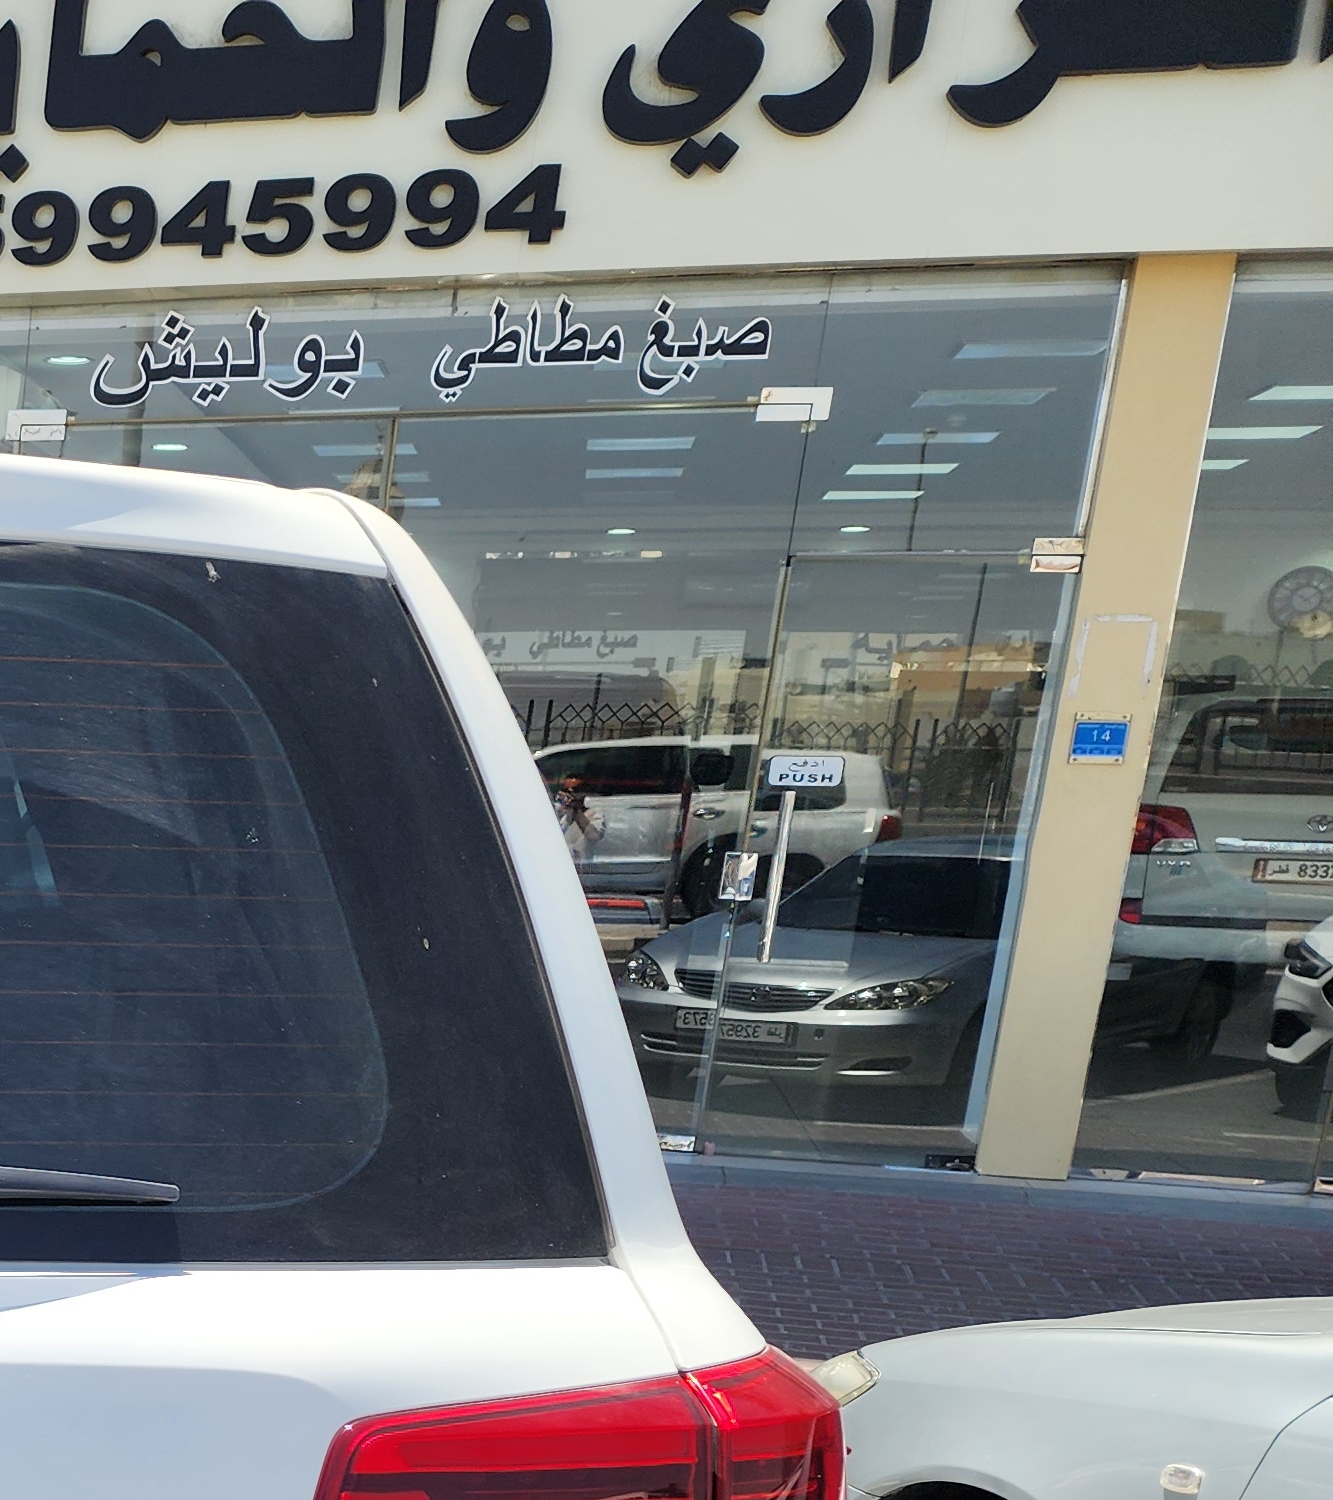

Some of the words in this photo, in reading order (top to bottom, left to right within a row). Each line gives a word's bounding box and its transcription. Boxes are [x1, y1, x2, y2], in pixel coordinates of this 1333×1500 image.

[90, 305, 365, 408] بوليش
[431, 295, 626, 403] مطاطي
[638, 296, 773, 396] صبغ
[778, 773, 834, 783] PUSH
[1092, 729, 1111, 742] 14
